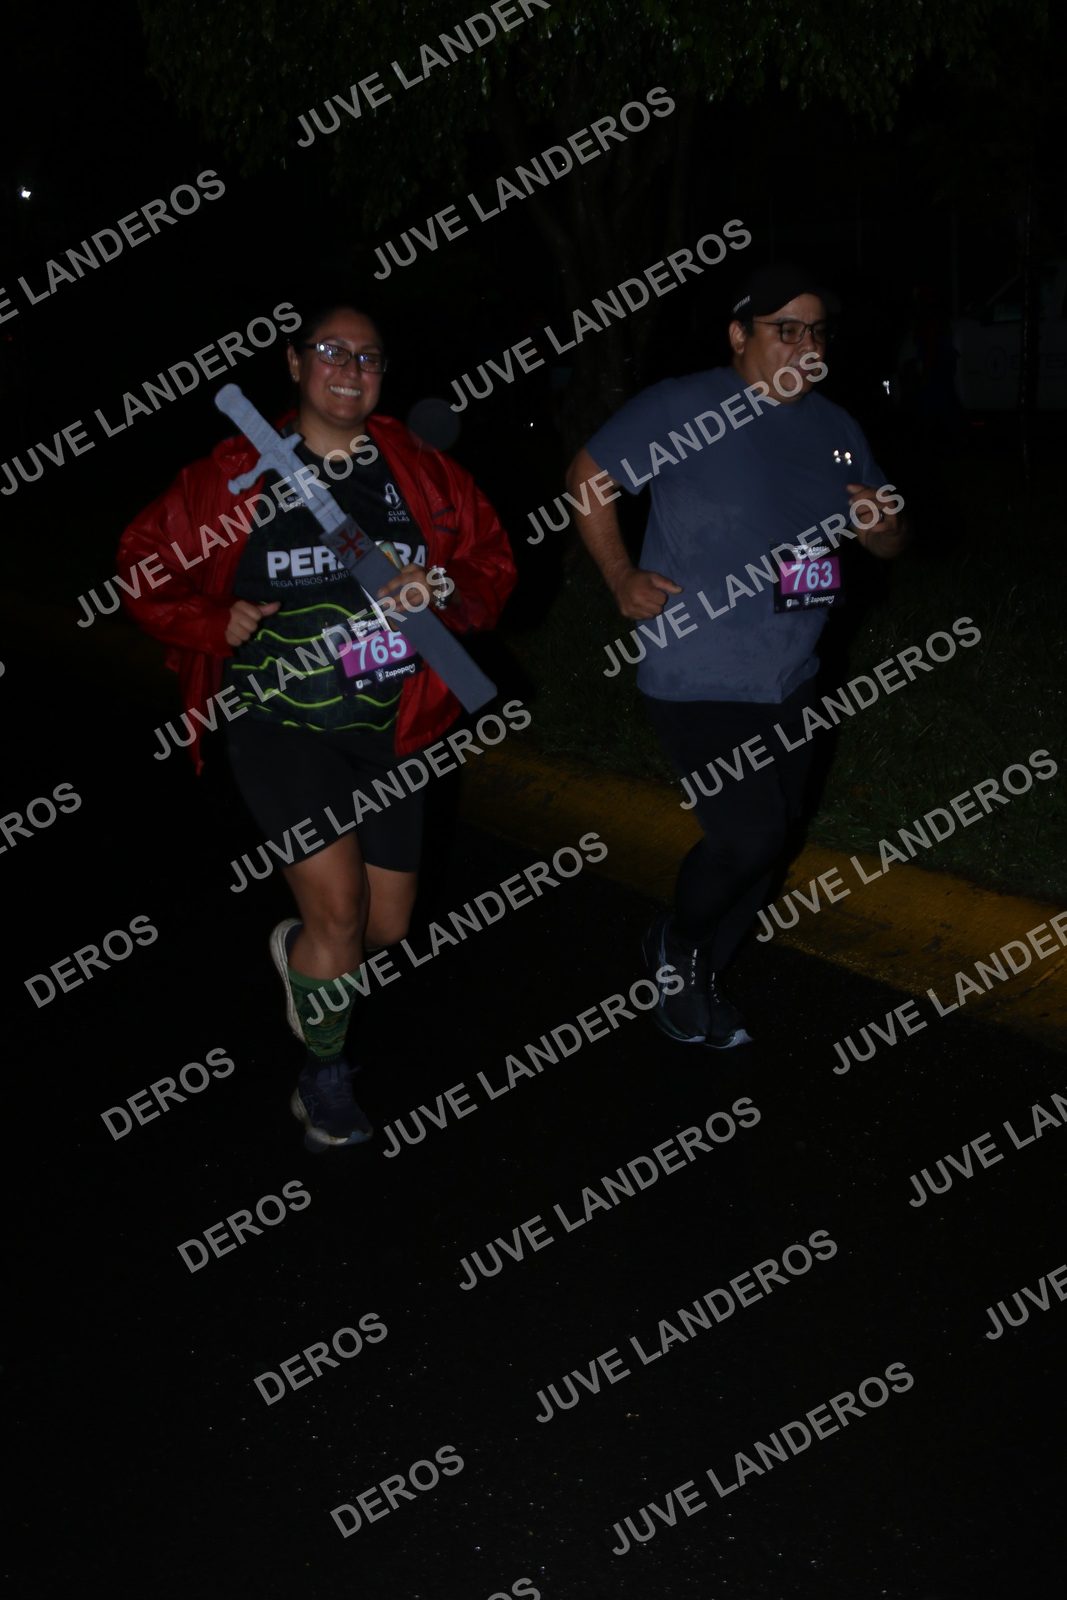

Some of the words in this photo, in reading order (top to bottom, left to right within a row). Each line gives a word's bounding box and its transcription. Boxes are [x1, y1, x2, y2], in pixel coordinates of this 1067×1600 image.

[267, 540, 426, 579] PERRA
[791, 560, 833, 591] 763
[271, 579, 294, 588] PEGA
[295, 577, 323, 587] PISOS
[352, 631, 407, 671] 765
